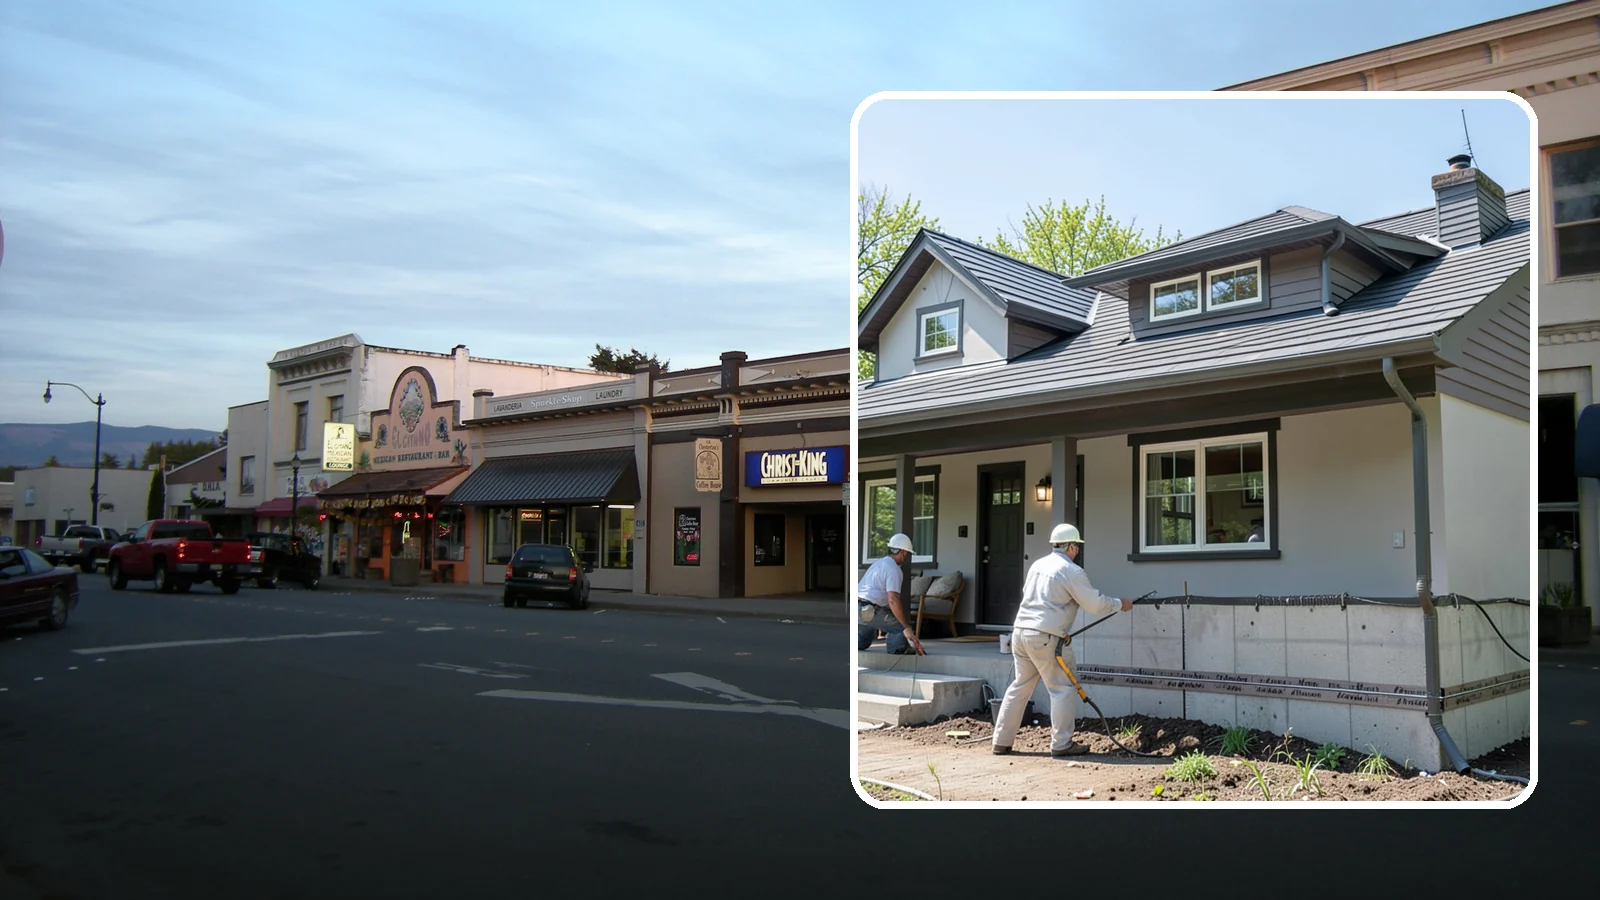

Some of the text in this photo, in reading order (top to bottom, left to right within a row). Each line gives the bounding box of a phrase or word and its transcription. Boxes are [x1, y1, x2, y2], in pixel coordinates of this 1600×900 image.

[596, 389, 623, 400] LAUNDRY
[494, 402, 522, 412] LAVANDERIA
[531, 395, 582, 409] Sparkle Shop
[374, 454, 397, 464] MEXICAN
[397, 451, 433, 462] RESTAURANT
[438, 450, 450, 459] BAR
[761, 450, 827, 478] CHRIST KING
